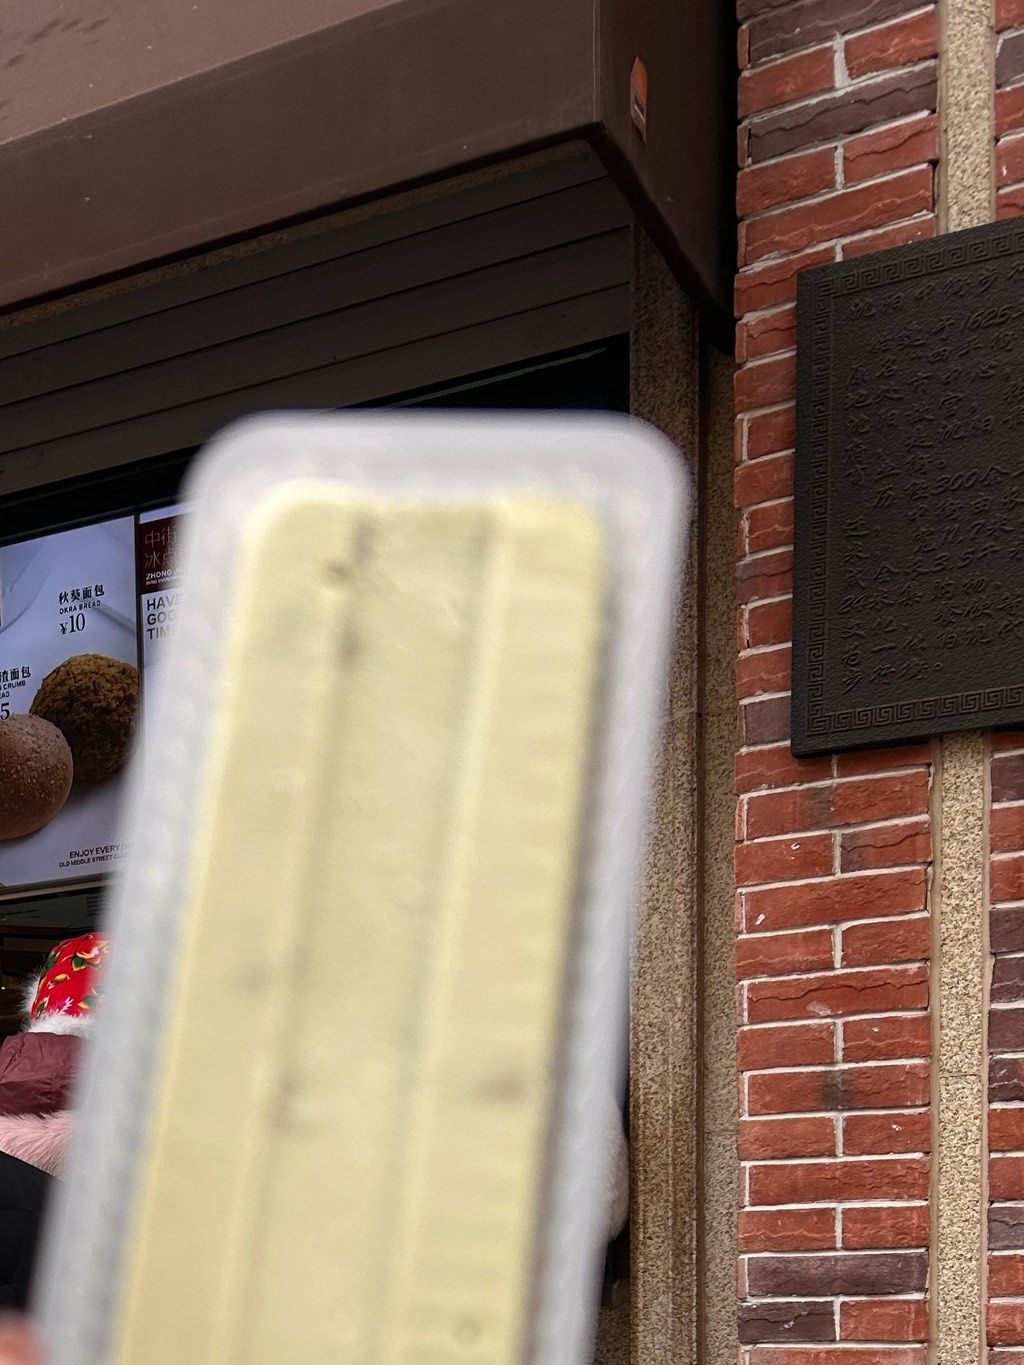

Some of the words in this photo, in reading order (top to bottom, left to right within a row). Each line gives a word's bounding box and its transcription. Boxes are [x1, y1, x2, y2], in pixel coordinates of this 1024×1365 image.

[59, 605, 77, 614] OKRA
[79, 600, 101, 610] BREAD
[59, 612, 85, 635] ¥10
[69, 848, 94, 859] ENJOY
